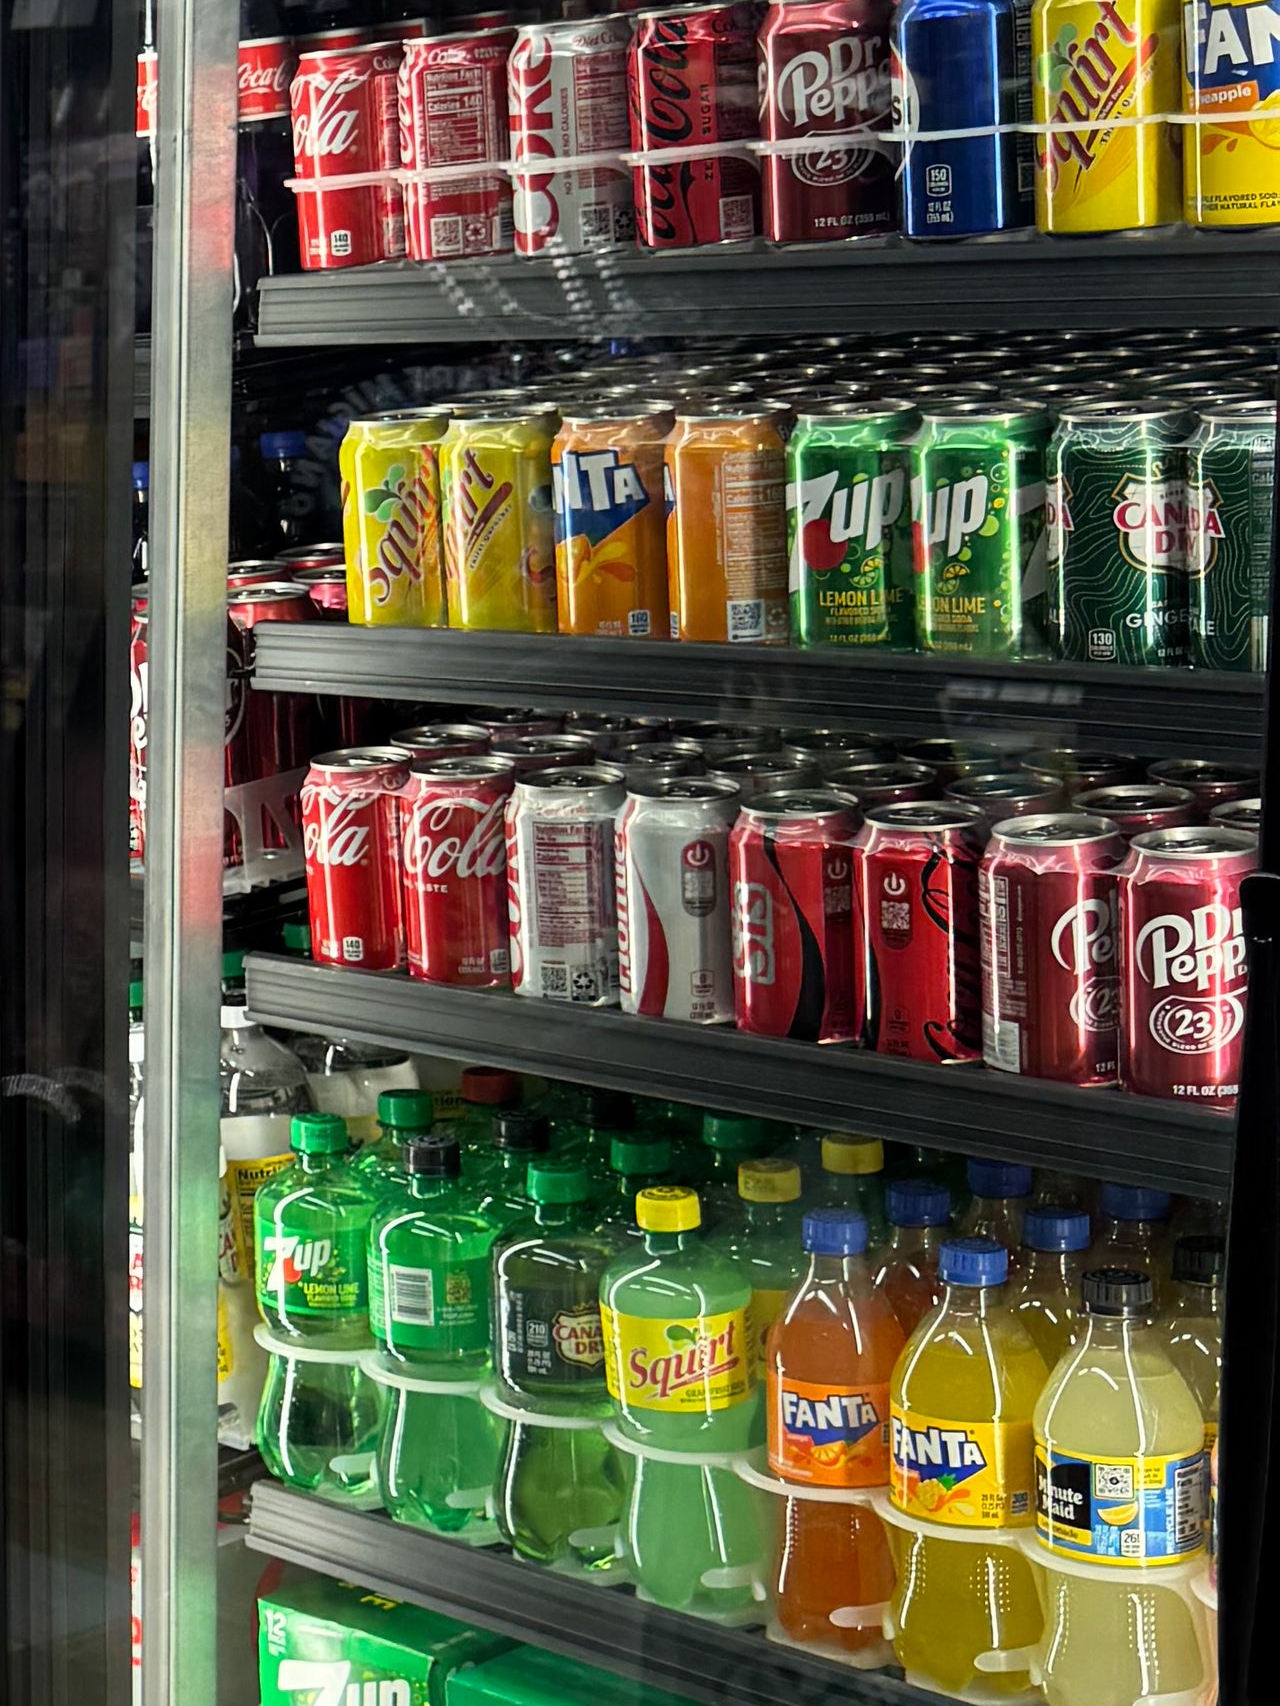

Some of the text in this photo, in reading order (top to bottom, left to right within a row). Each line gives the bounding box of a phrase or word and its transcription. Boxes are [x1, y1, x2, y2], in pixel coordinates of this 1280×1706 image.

[828, 36, 881, 71] Dr
[786, 466, 905, 593] 7up
[819, 589, 867, 610] LEMON
[952, 595, 986, 616] LIME
[1174, 1012, 1211, 1040] 23
[264, 1235, 331, 1292] 7up
[630, 1320, 737, 1398] Squirt
[782, 1391, 878, 1432] FANTA
[892, 1417, 987, 1466] FANTA
[264, 1609, 288, 1634] 12
